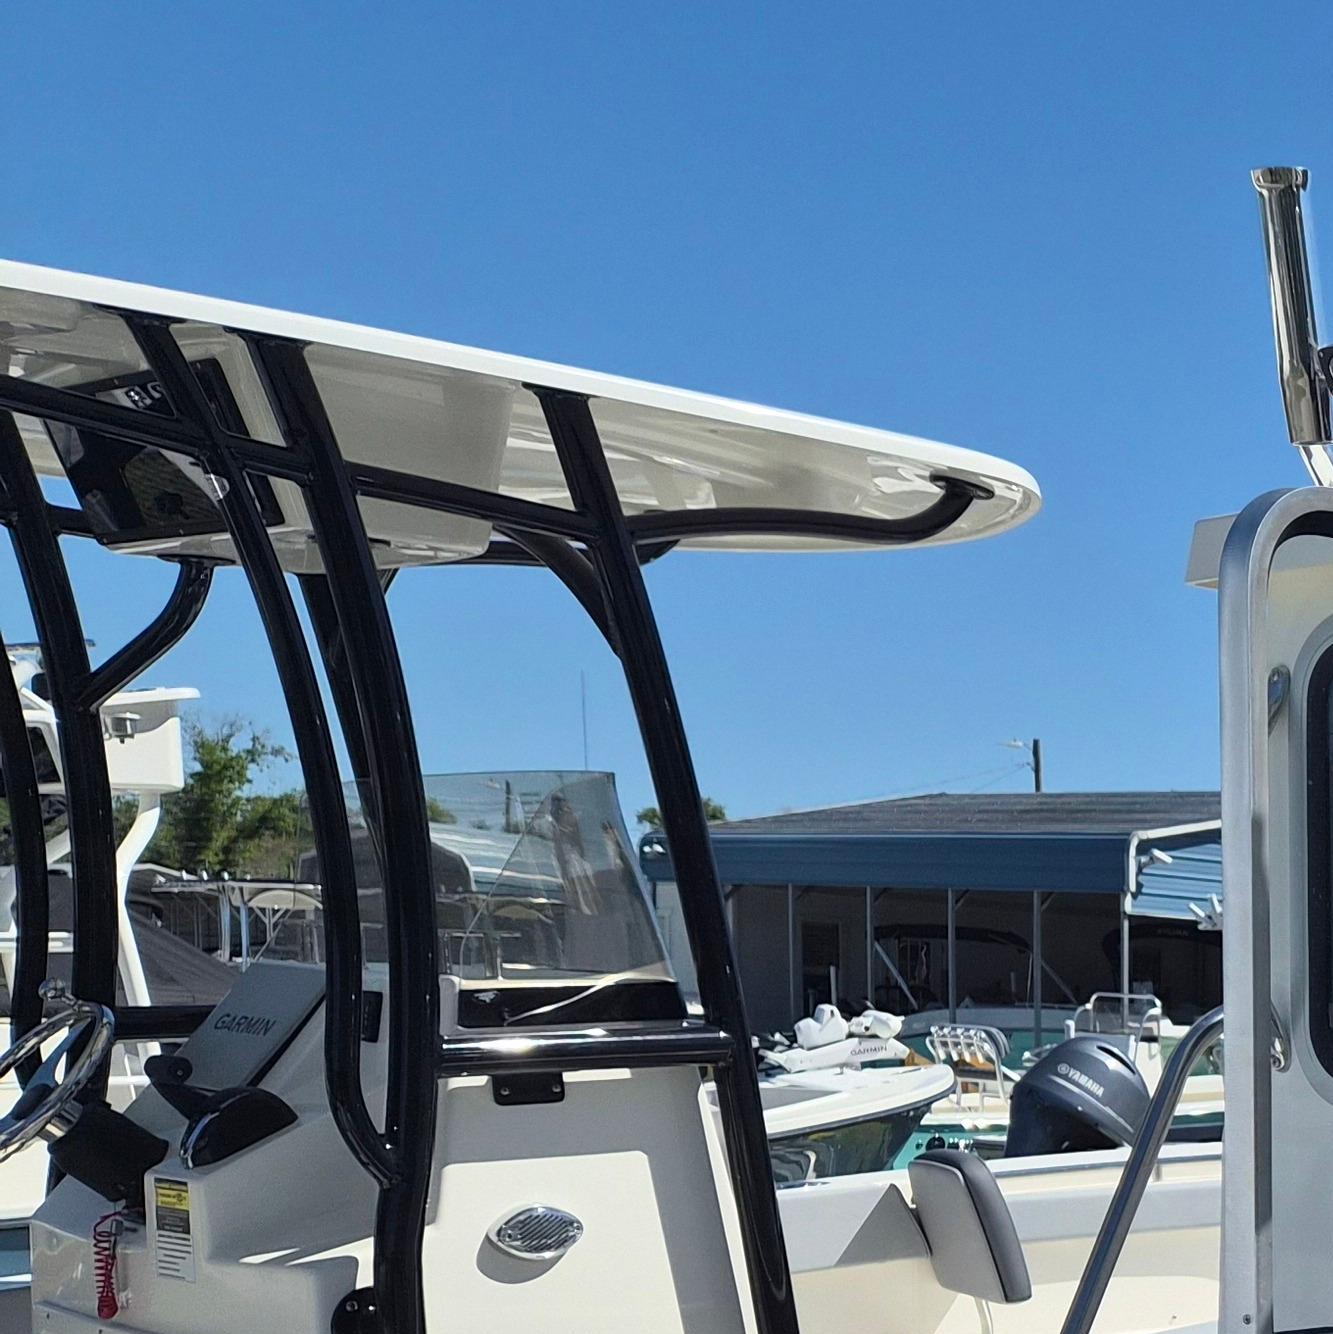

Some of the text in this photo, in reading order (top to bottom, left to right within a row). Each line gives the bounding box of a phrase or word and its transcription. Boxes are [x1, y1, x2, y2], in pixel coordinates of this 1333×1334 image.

[214, 1013, 276, 1037] GARMIN
[850, 1044, 888, 1056] GARMIN
[1068, 1067, 1104, 1098] YAMAHA
